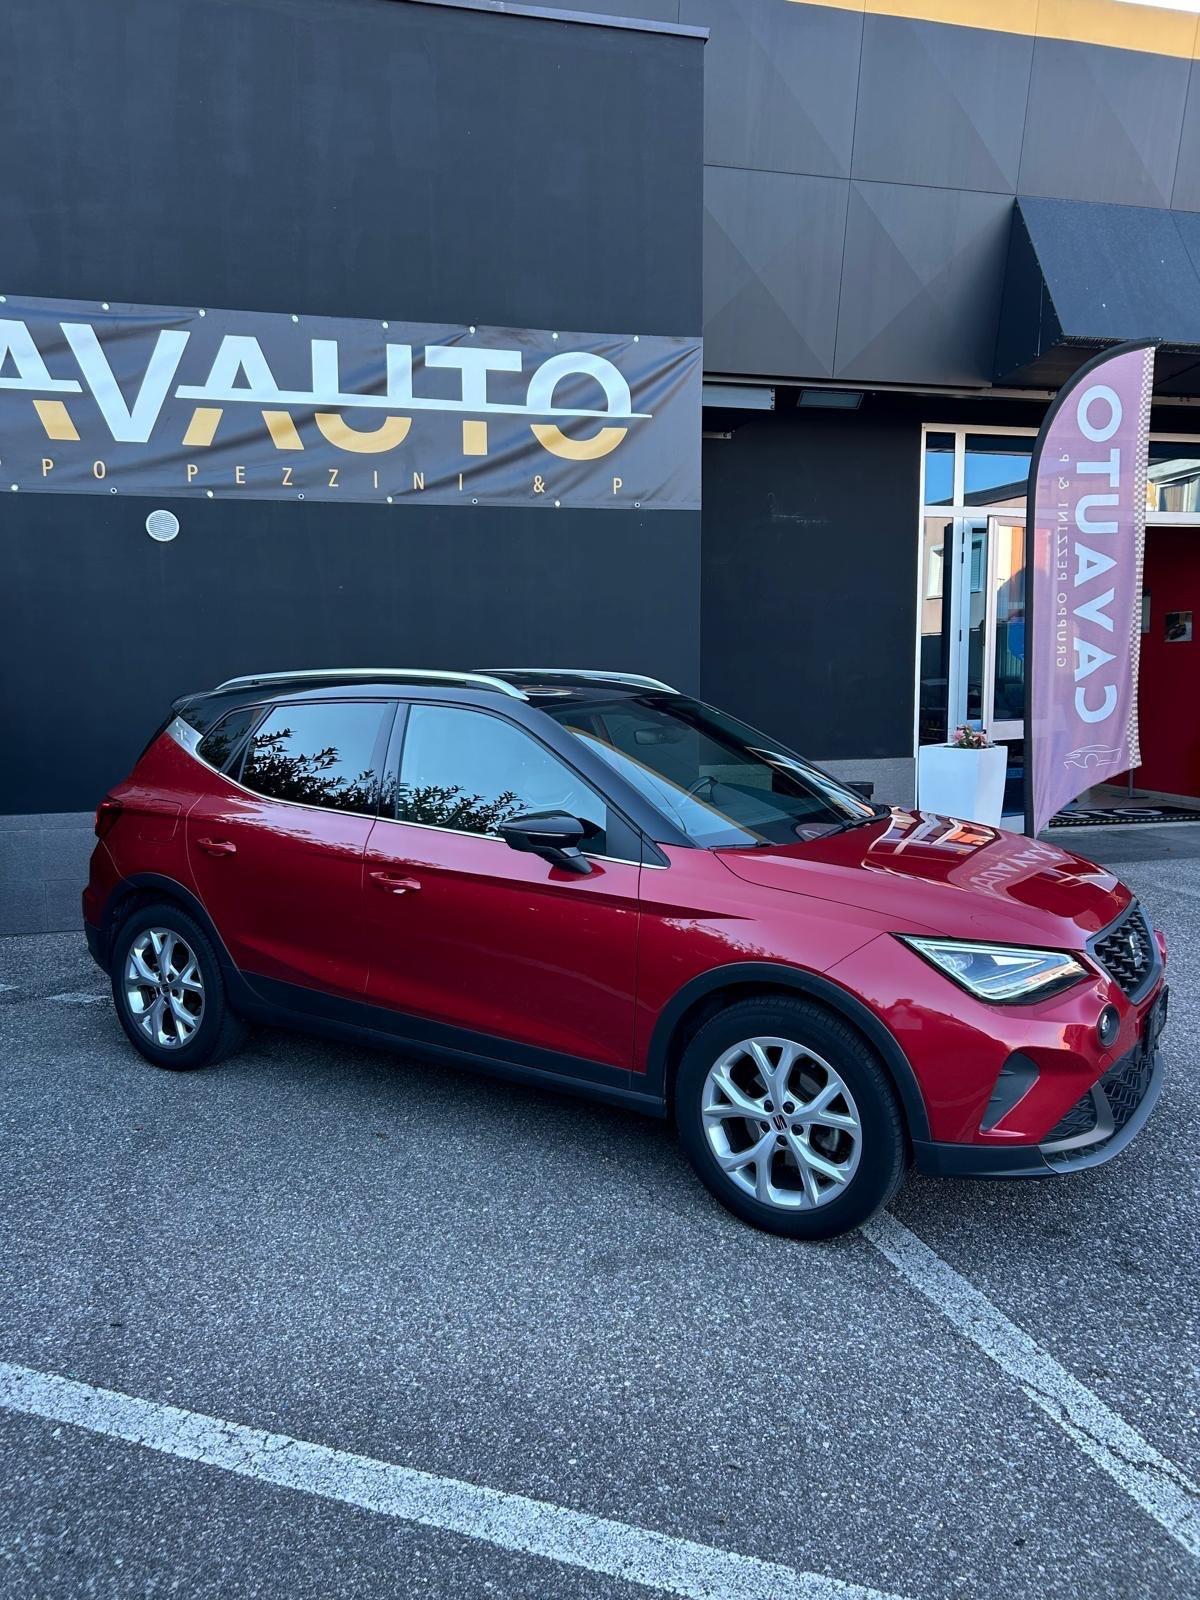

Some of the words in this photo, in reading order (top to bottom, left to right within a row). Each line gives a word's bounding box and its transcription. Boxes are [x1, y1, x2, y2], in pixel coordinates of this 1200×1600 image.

[0, 318, 634, 461] AVAUTO
[186, 463, 464, 492] PEZZINI
[533, 474, 545, 493] &
[612, 476, 623, 495] P
[1055, 807, 1163, 819] UTO
